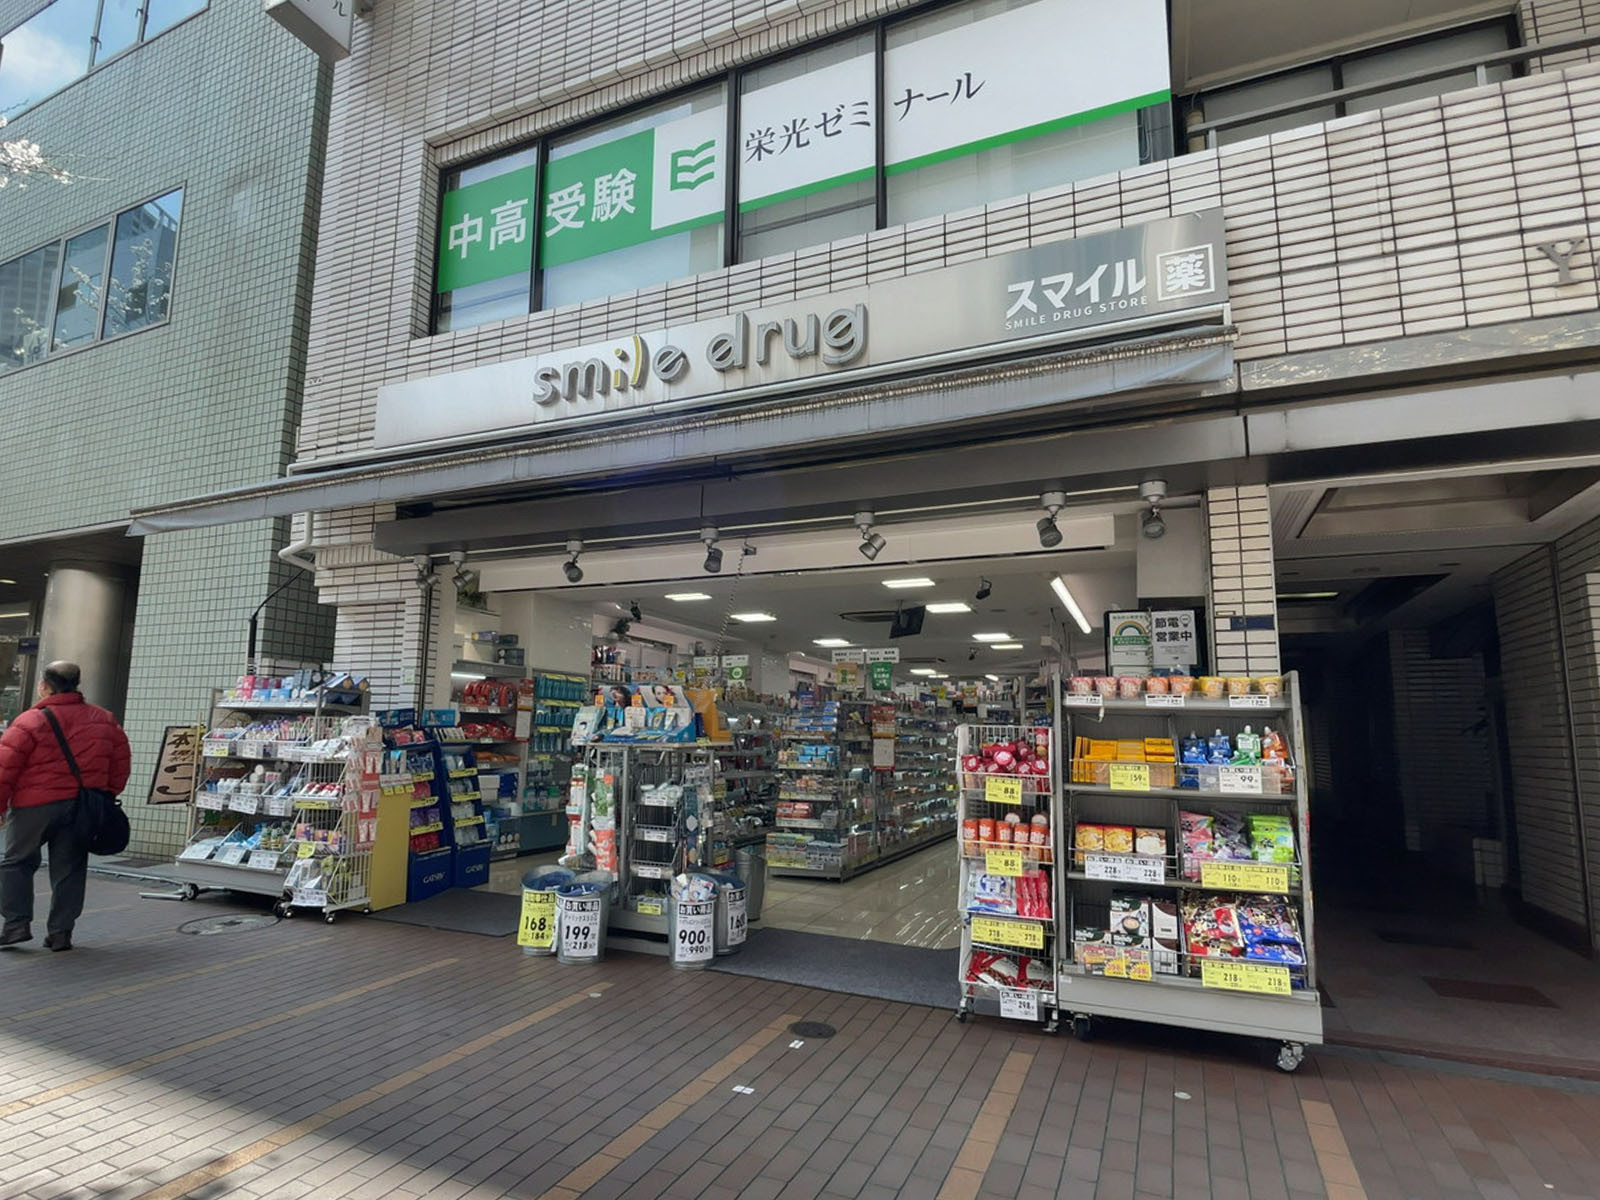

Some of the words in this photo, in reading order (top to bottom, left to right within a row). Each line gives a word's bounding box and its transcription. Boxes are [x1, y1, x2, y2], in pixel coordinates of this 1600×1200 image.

[744, 72, 986, 164] 栄光ゼミナール
[447, 167, 638, 260] 中高受験
[1164, 253, 1206, 292] 薬
[1005, 258, 1146, 320] スマイル
[1004, 313, 1048, 331] SMILE
[1052, 304, 1094, 323] DRUG
[1099, 295, 1149, 315] STORE
[532, 333, 690, 408] smile
[705, 302, 869, 371] drug
[1155, 617, 1180, 629] 節電
[1155, 630, 1193, 643] 営業中
[525, 916, 547, 931] 168
[565, 925, 591, 940] 199
[679, 929, 706, 945] 900
[1223, 972, 1239, 982] 218
[1267, 977, 1283, 987] 218
